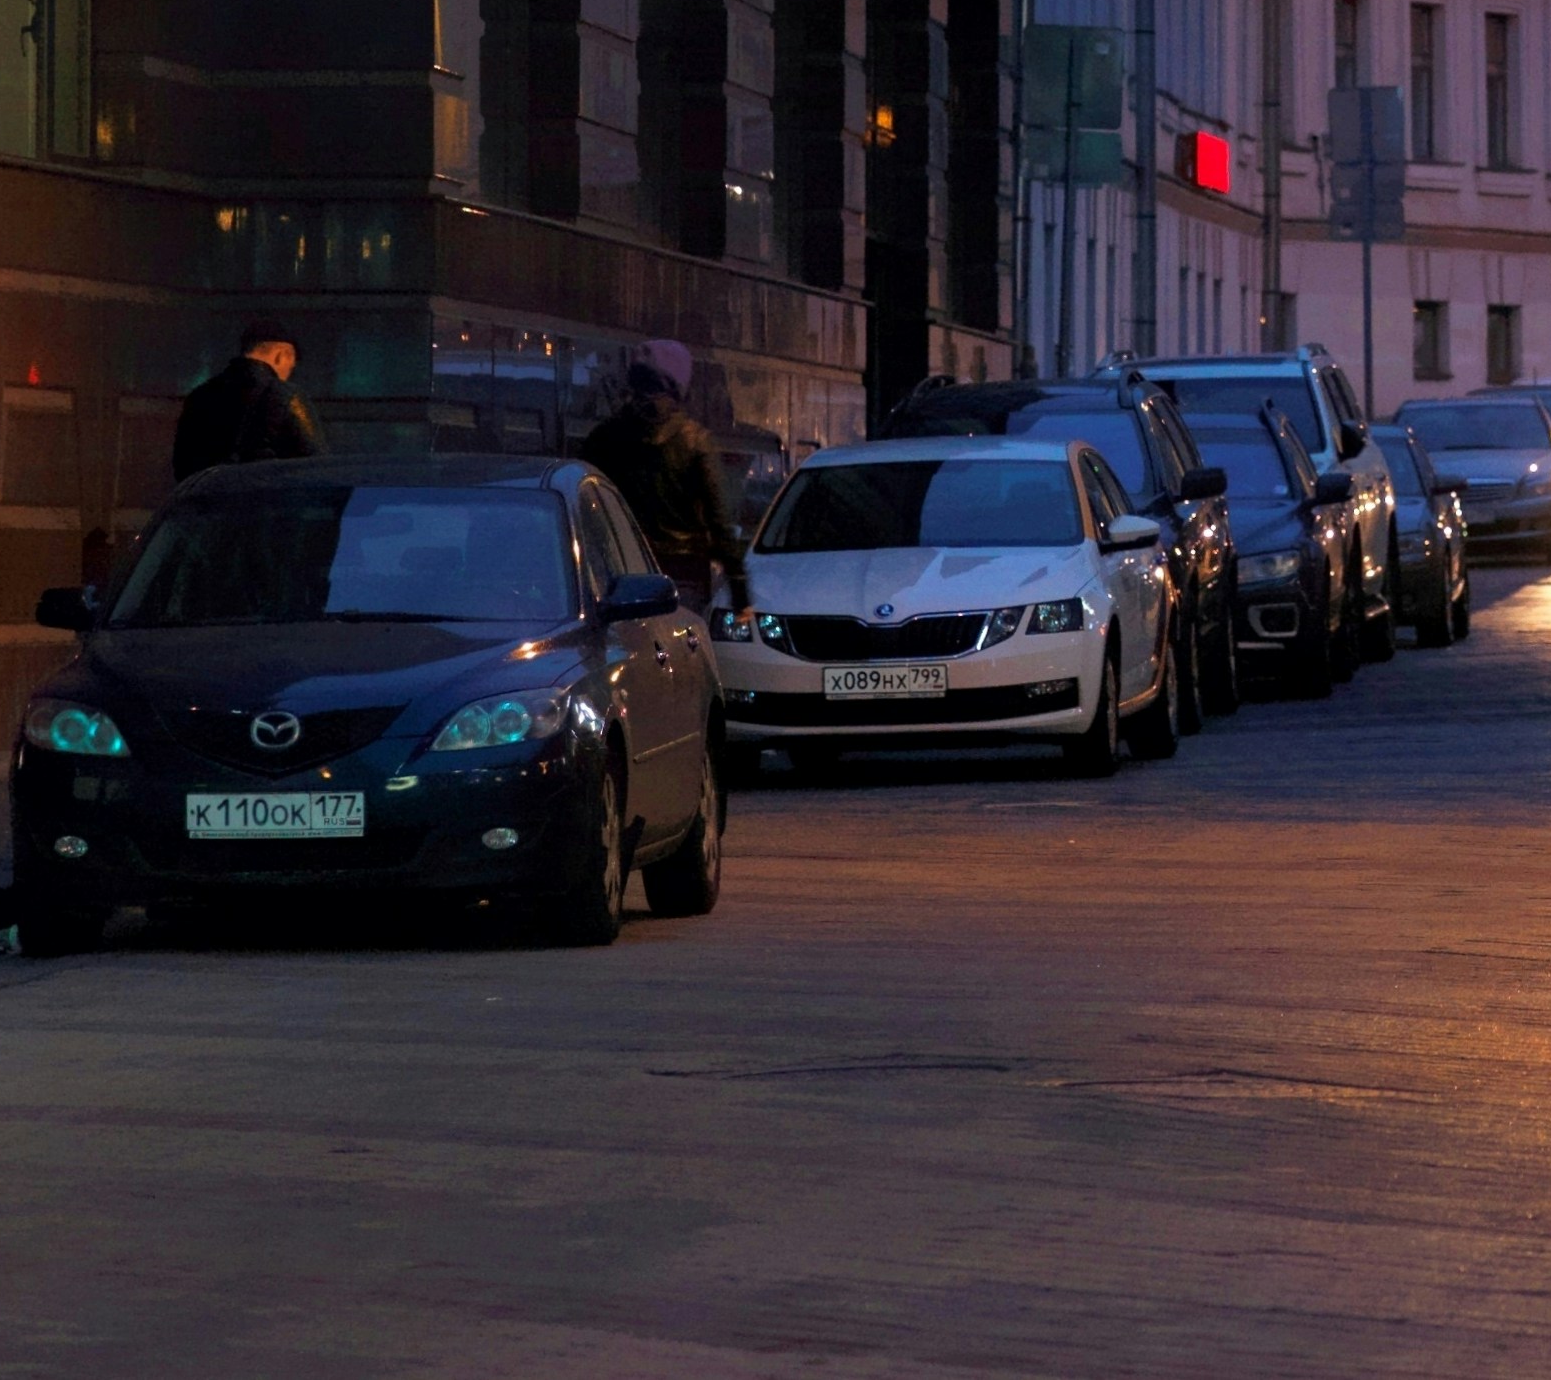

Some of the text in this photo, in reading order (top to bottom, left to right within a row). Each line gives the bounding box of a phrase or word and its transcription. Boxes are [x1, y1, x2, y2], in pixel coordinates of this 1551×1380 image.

[910, 668, 941, 684] 799
[314, 794, 356, 817] 177
[323, 817, 345, 826] RUS
